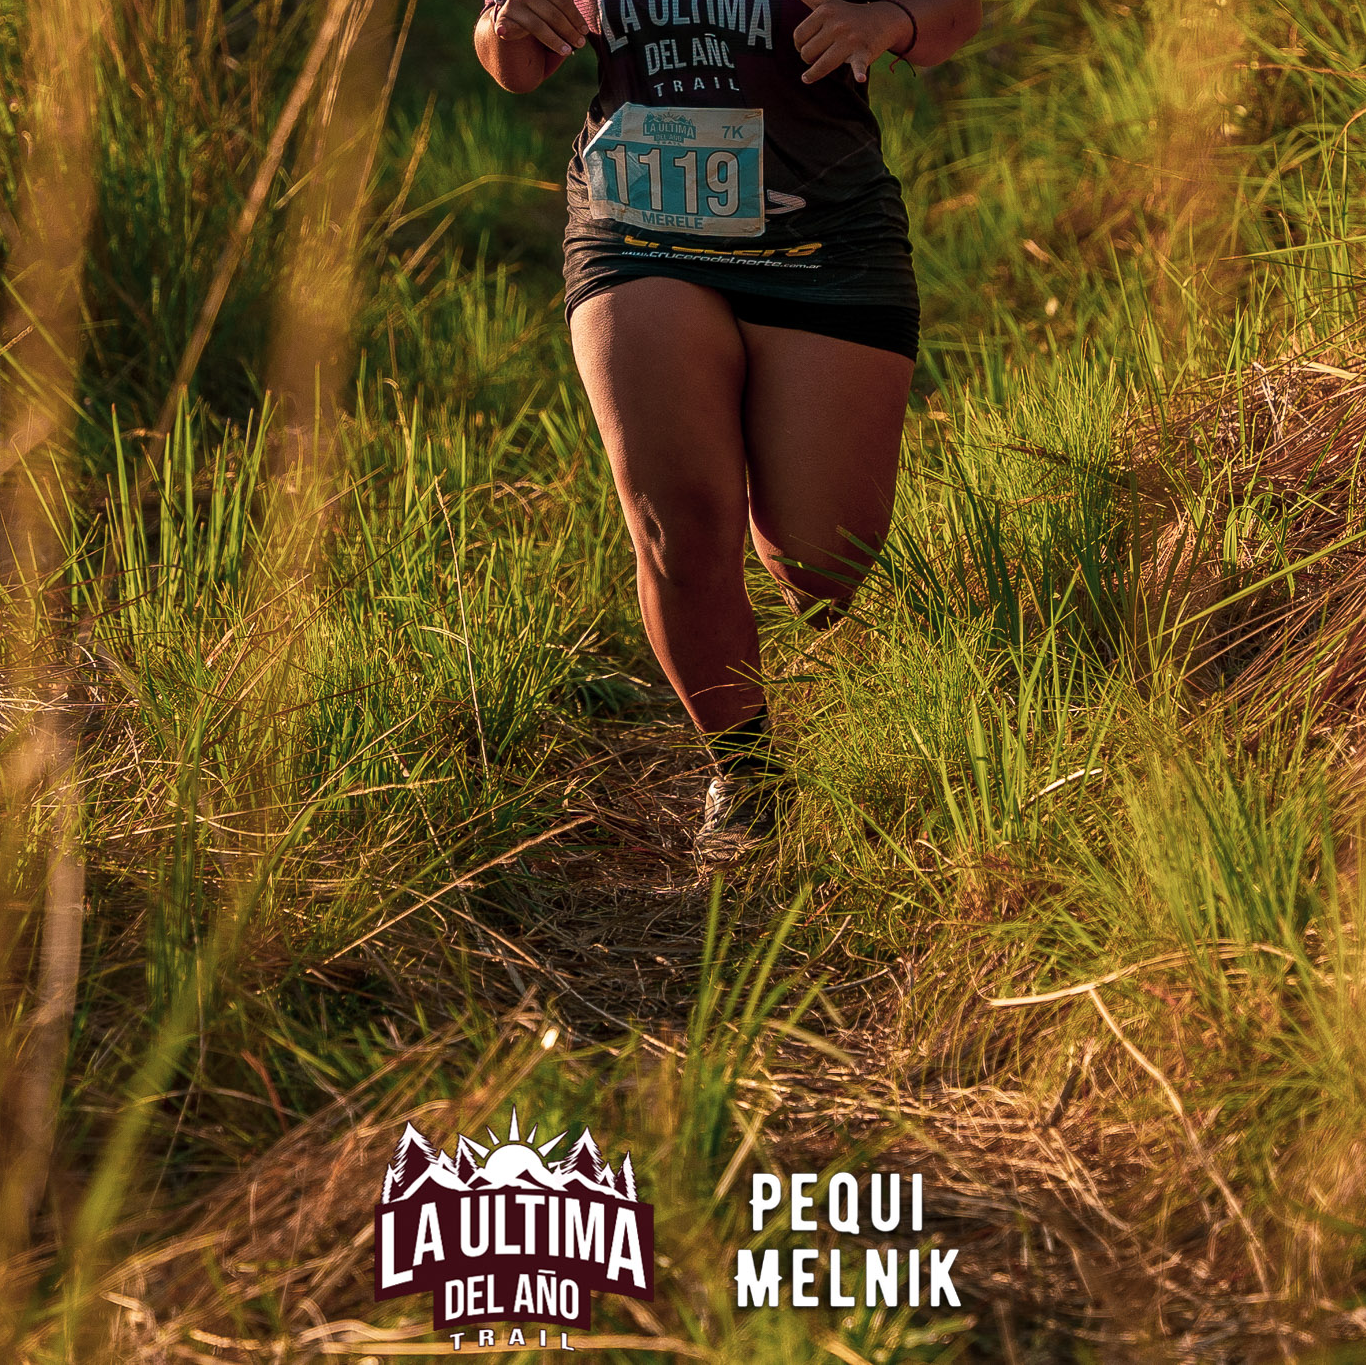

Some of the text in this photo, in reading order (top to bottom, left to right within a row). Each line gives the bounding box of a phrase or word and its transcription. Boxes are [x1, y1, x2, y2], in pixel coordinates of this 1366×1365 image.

[644, 38, 687, 76] DEL
[653, 76, 740, 97] TRAIL
[644, 122, 744, 139] LA ULTIMA 7K
[604, 143, 740, 217] 1119
[642, 210, 705, 230] MERELE
